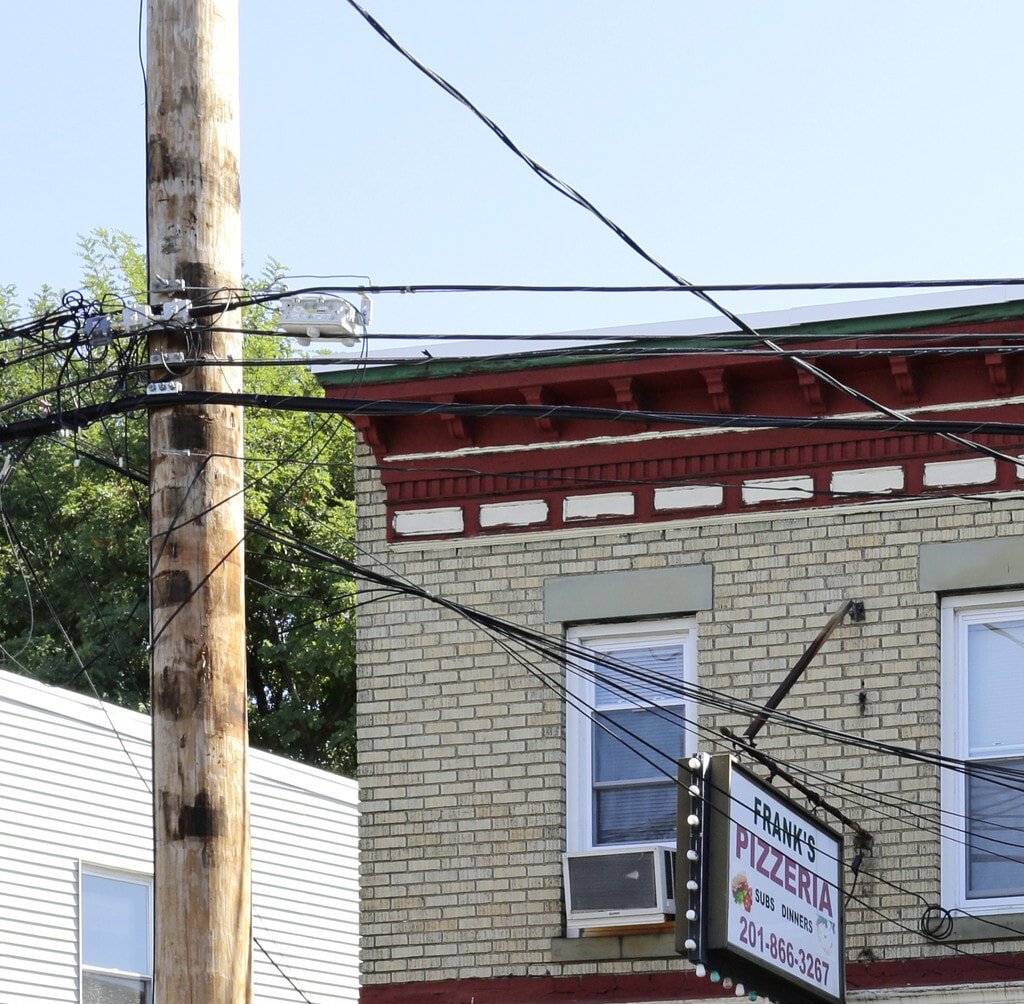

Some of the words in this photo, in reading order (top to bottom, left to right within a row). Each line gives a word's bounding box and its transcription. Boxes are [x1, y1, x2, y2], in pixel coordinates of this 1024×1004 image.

[754, 796, 816, 863] FRANK'S
[736, 824, 833, 918] PIZZERIA
[755, 889, 775, 912] SUBS
[781, 903, 813, 934] DINNERS
[739, 916, 830, 986] 201-866-3267
